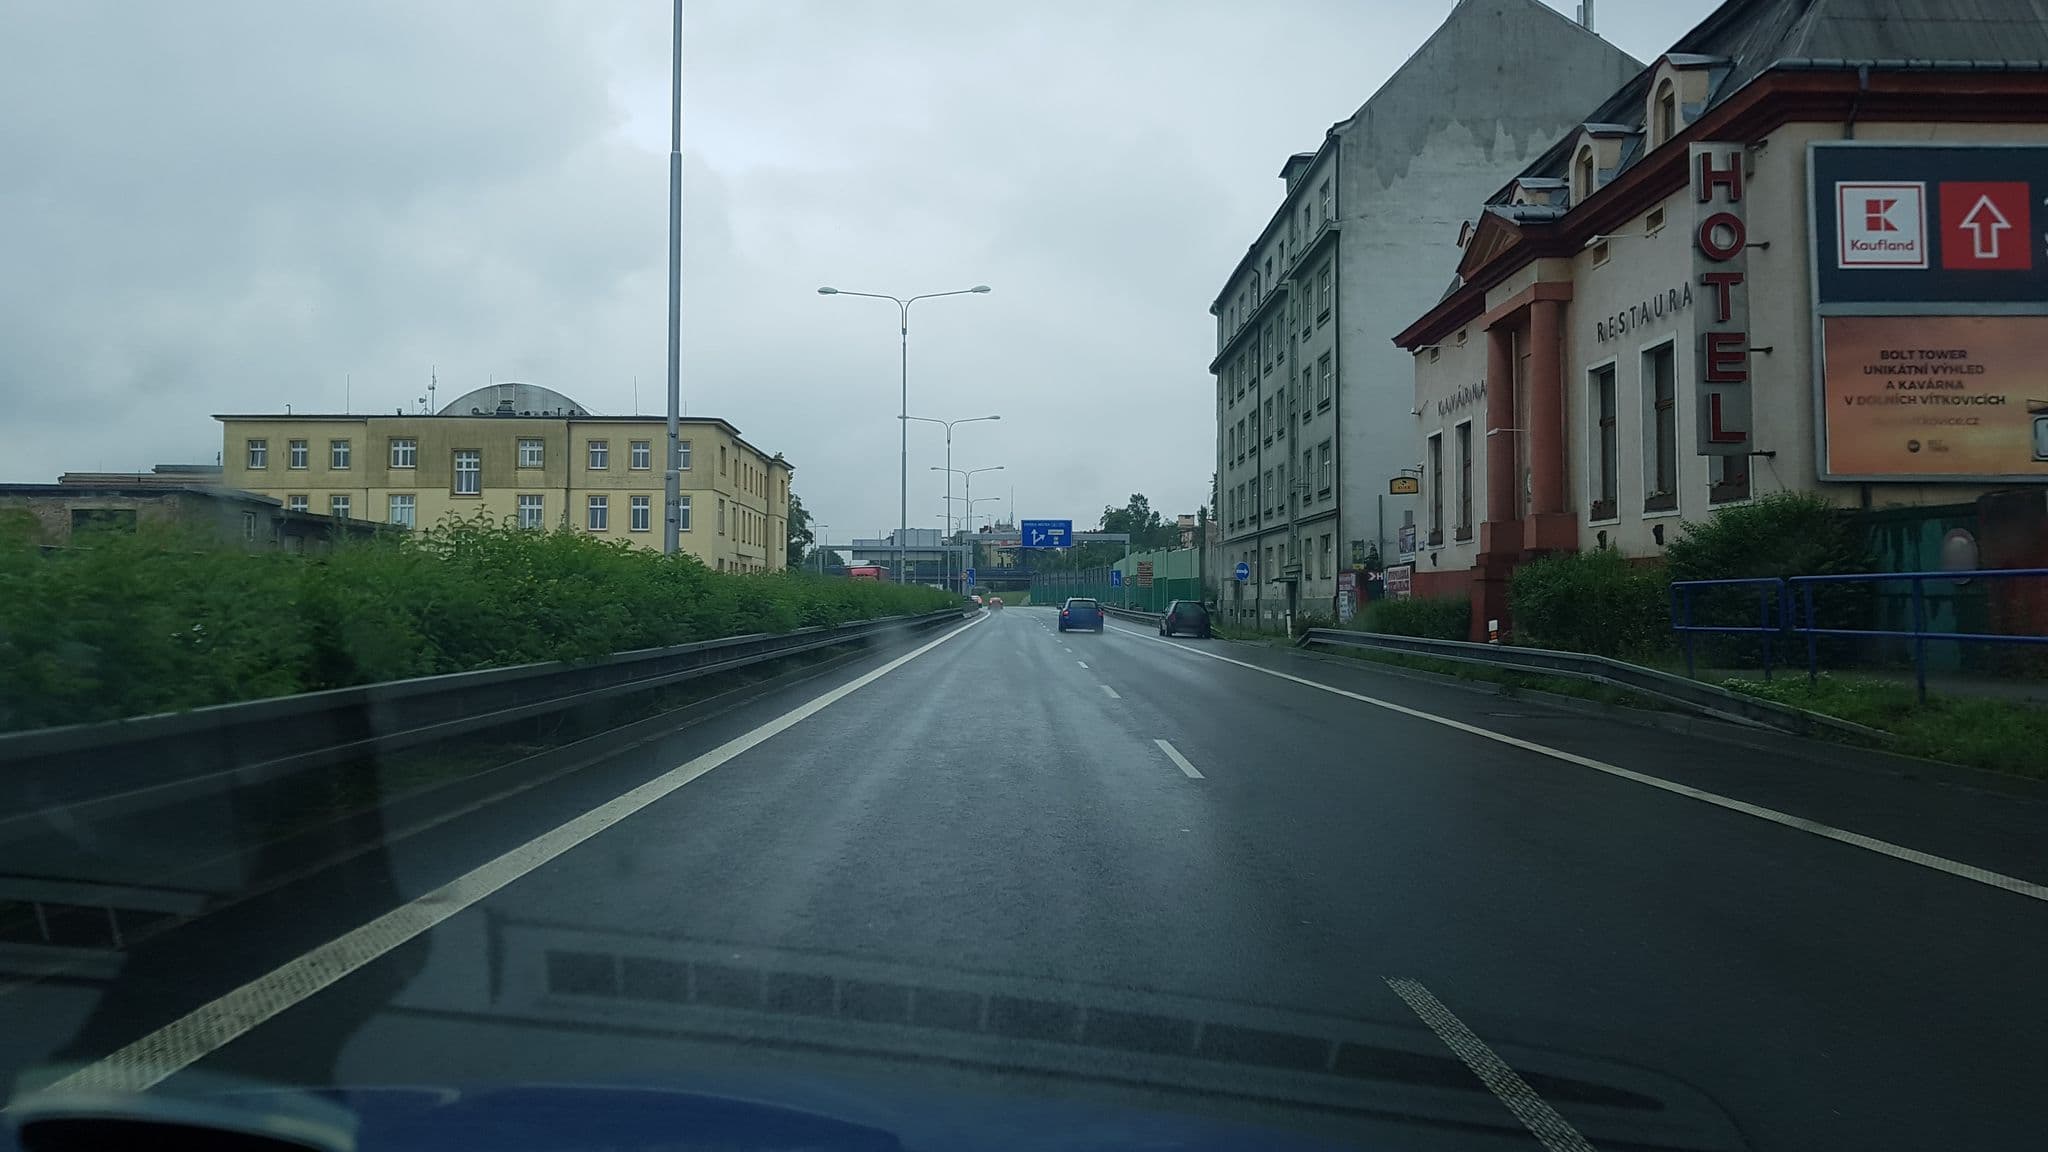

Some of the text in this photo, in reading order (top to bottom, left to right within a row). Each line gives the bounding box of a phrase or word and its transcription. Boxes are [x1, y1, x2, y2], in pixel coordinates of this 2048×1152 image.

[1850, 238, 1915, 252] Kaufland
[1699, 151, 1748, 443] HOTEL
[1880, 349, 1968, 360] BOLT TOWER
[1863, 363, 1985, 375] UNIKÁTNÍ VÝHLED
[1886, 378, 1965, 390] A KAVÁRNA
[1844, 393, 2006, 406] V DOLNÍCH VÍTKOVICÍCH
